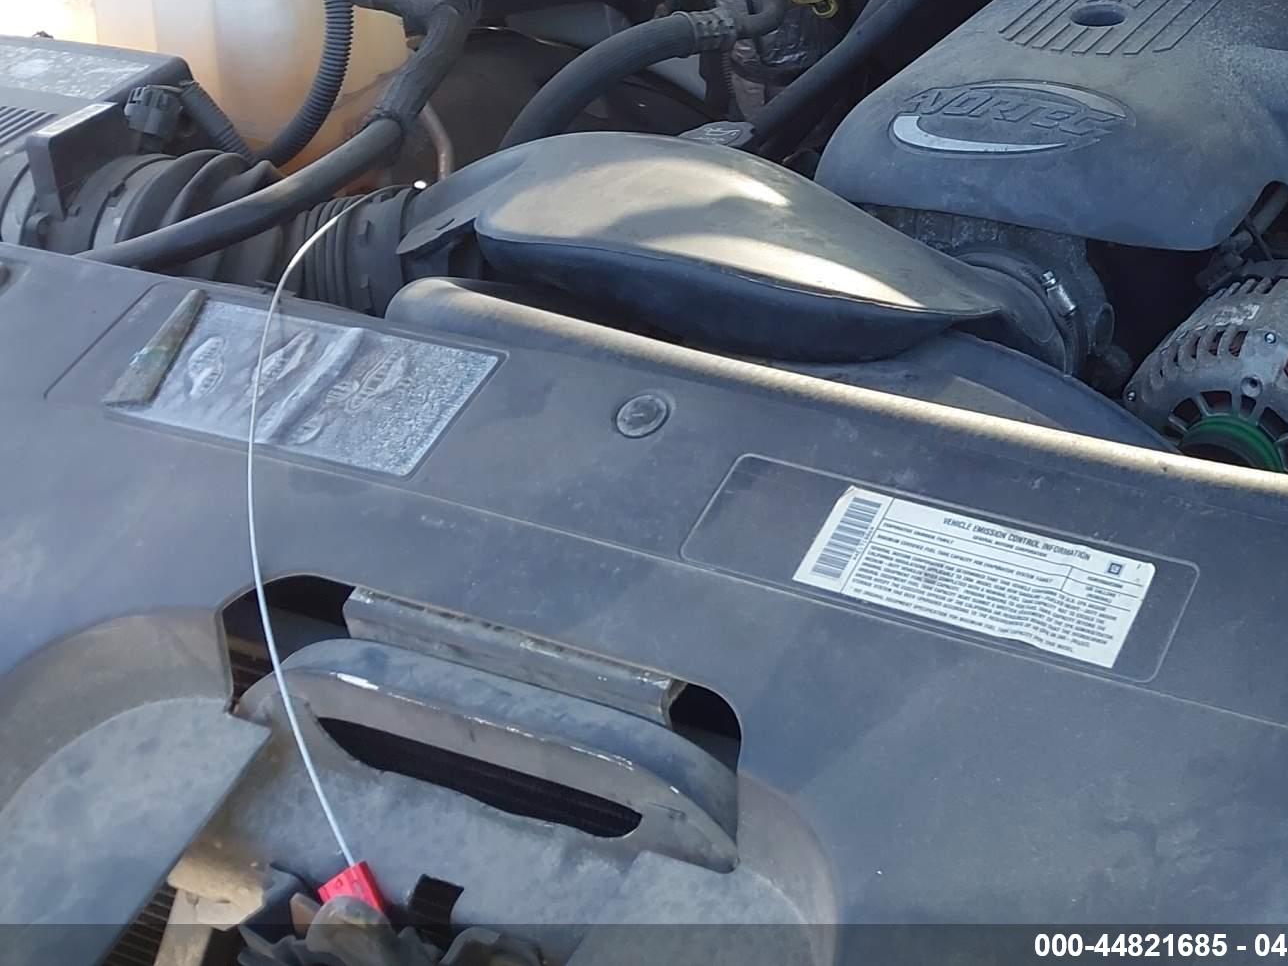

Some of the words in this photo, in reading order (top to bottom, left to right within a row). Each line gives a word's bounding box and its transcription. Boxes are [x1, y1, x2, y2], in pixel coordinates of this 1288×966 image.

[943, 517, 971, 530] VEHICLE
[972, 525, 1007, 539] EMISSION
[1007, 534, 1040, 549] CONTROL
[1041, 542, 1091, 561] INFORMATION
